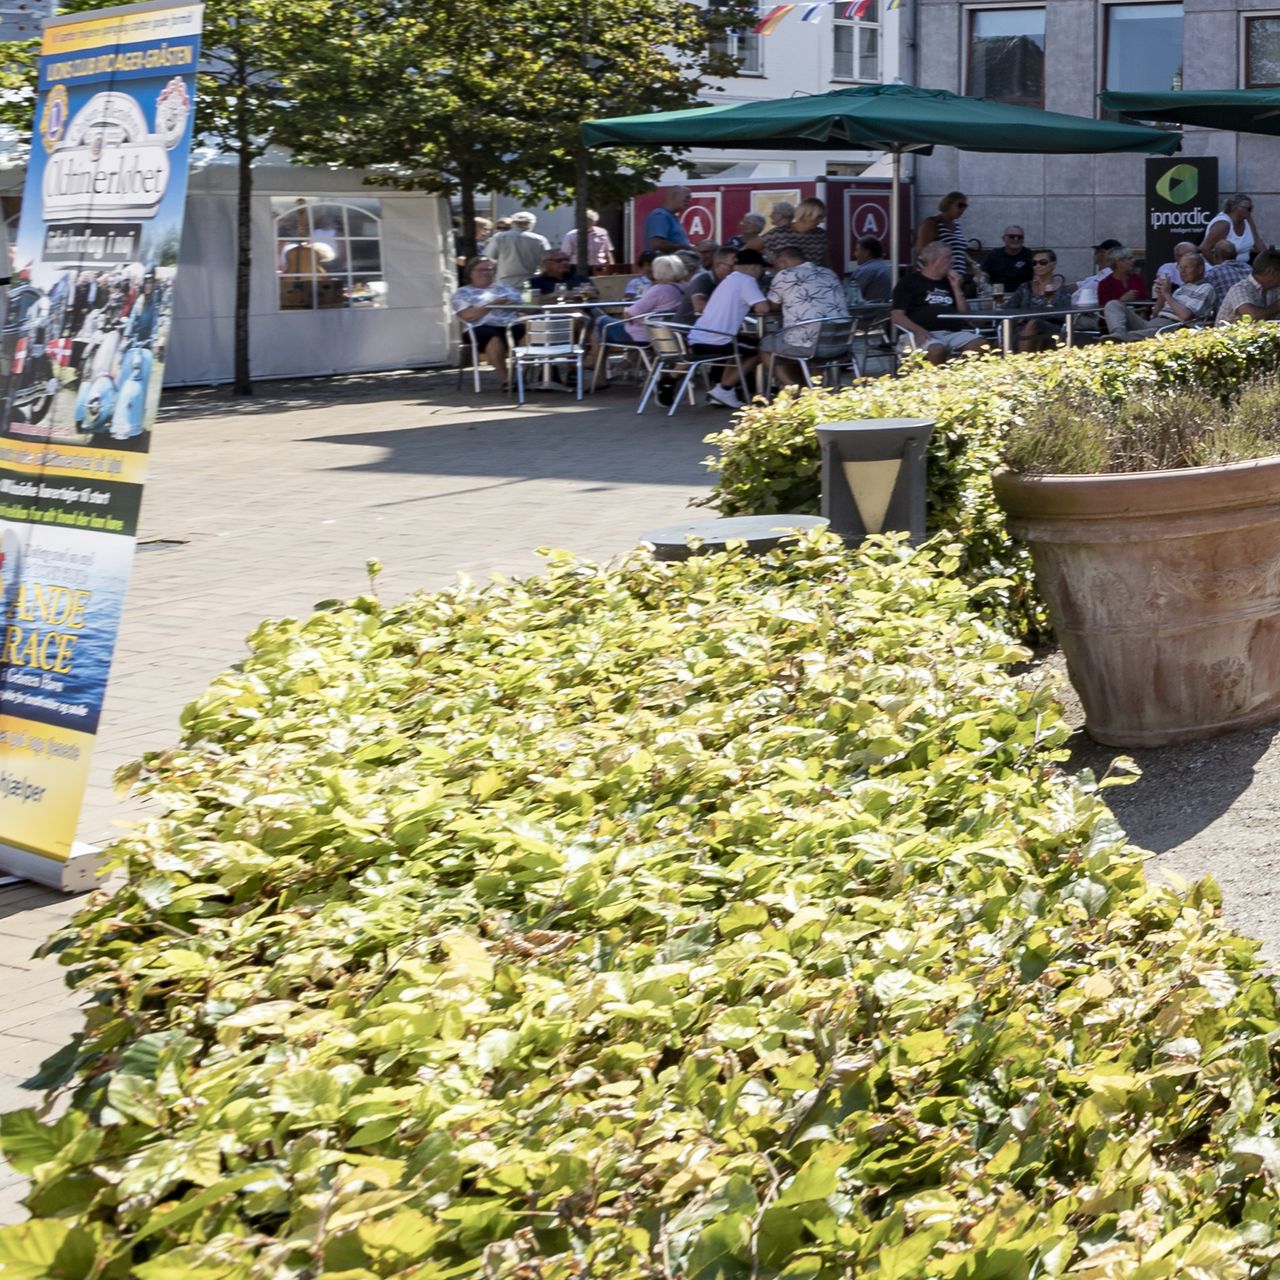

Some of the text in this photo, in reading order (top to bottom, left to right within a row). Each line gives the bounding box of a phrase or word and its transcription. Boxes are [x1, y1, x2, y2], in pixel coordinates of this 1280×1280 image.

[689, 216, 705, 236] A
[862, 212, 878, 232] A
[1151, 207, 1211, 230] ipnordic
[7, 581, 91, 630] ANDE
[1, 624, 78, 674] RACE
